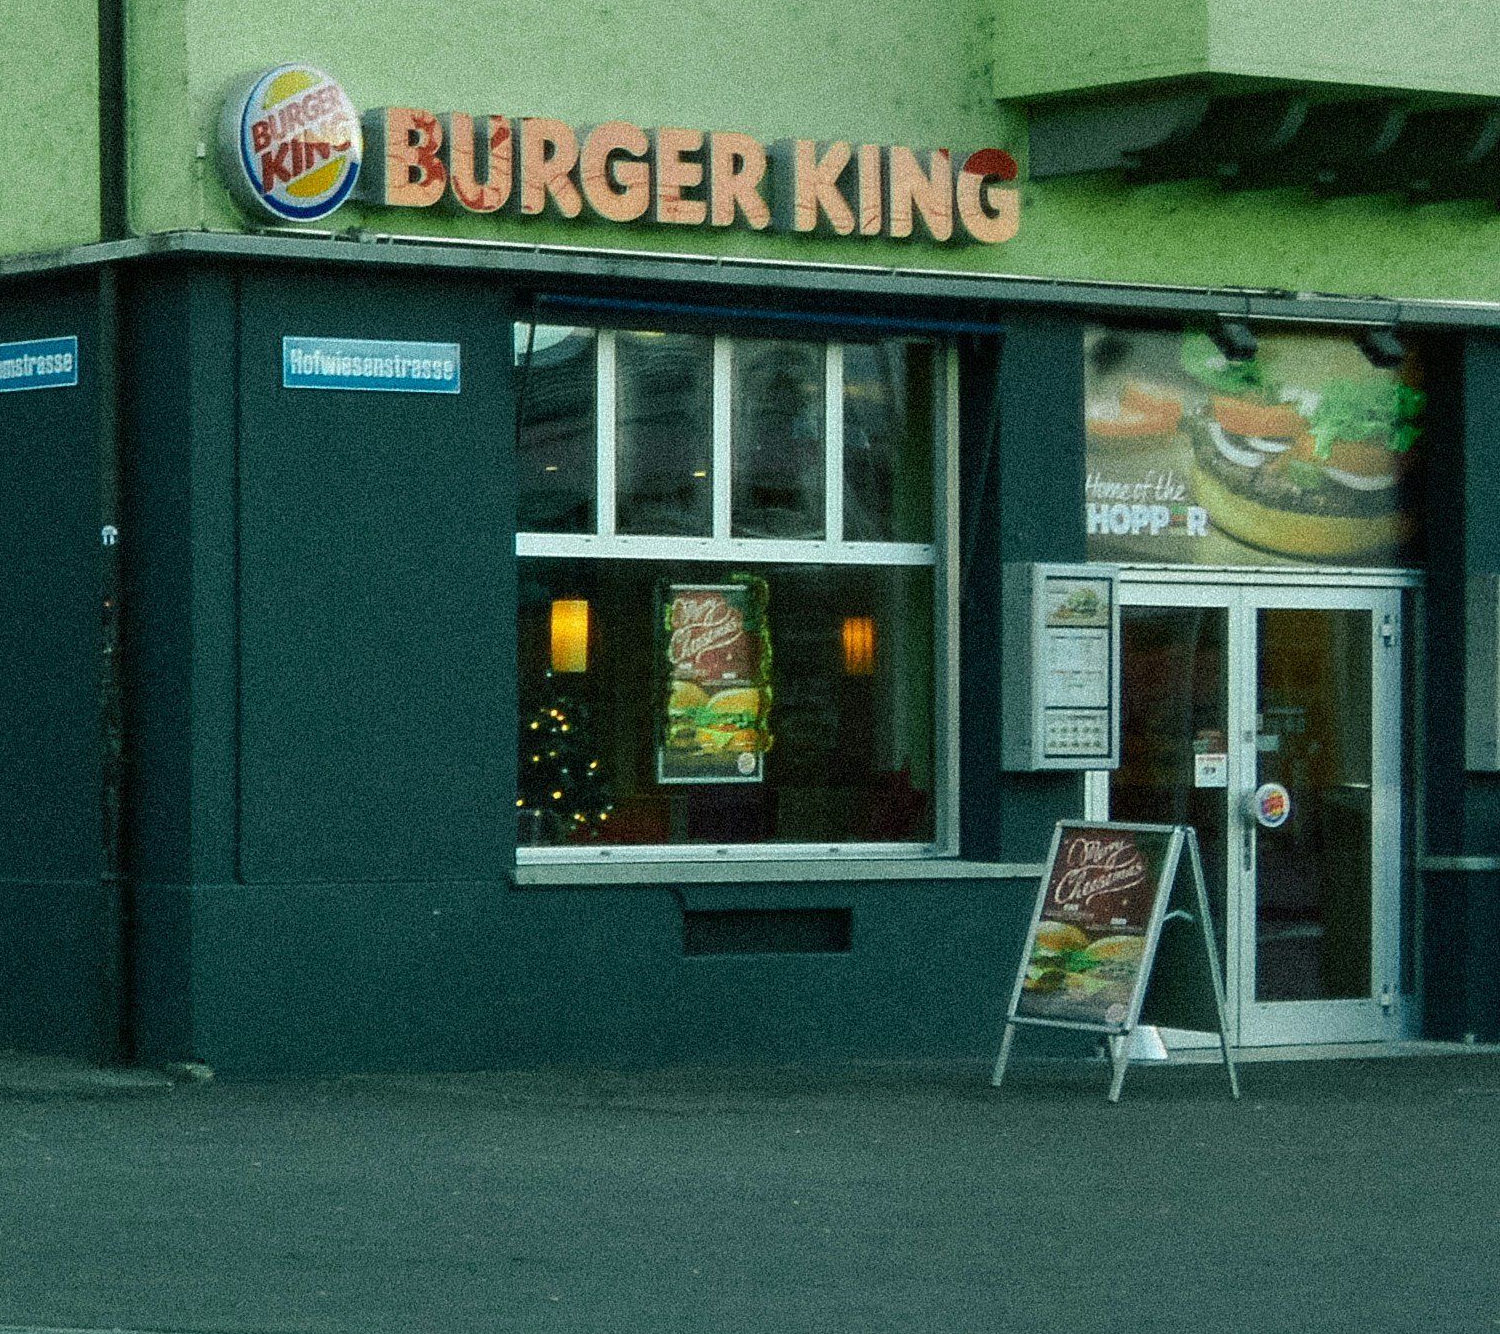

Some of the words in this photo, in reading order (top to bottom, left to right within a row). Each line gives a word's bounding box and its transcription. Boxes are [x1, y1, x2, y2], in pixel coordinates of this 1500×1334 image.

[251, 83, 343, 154] BURGER
[259, 114, 353, 196] KING
[384, 106, 770, 231] BURGER
[793, 138, 1021, 244] KING
[288, 348, 456, 381] Hofwiesenstrasse
[1085, 472, 1131, 500] Home
[1133, 470, 1154, 503] of
[1155, 467, 1186, 501] the
